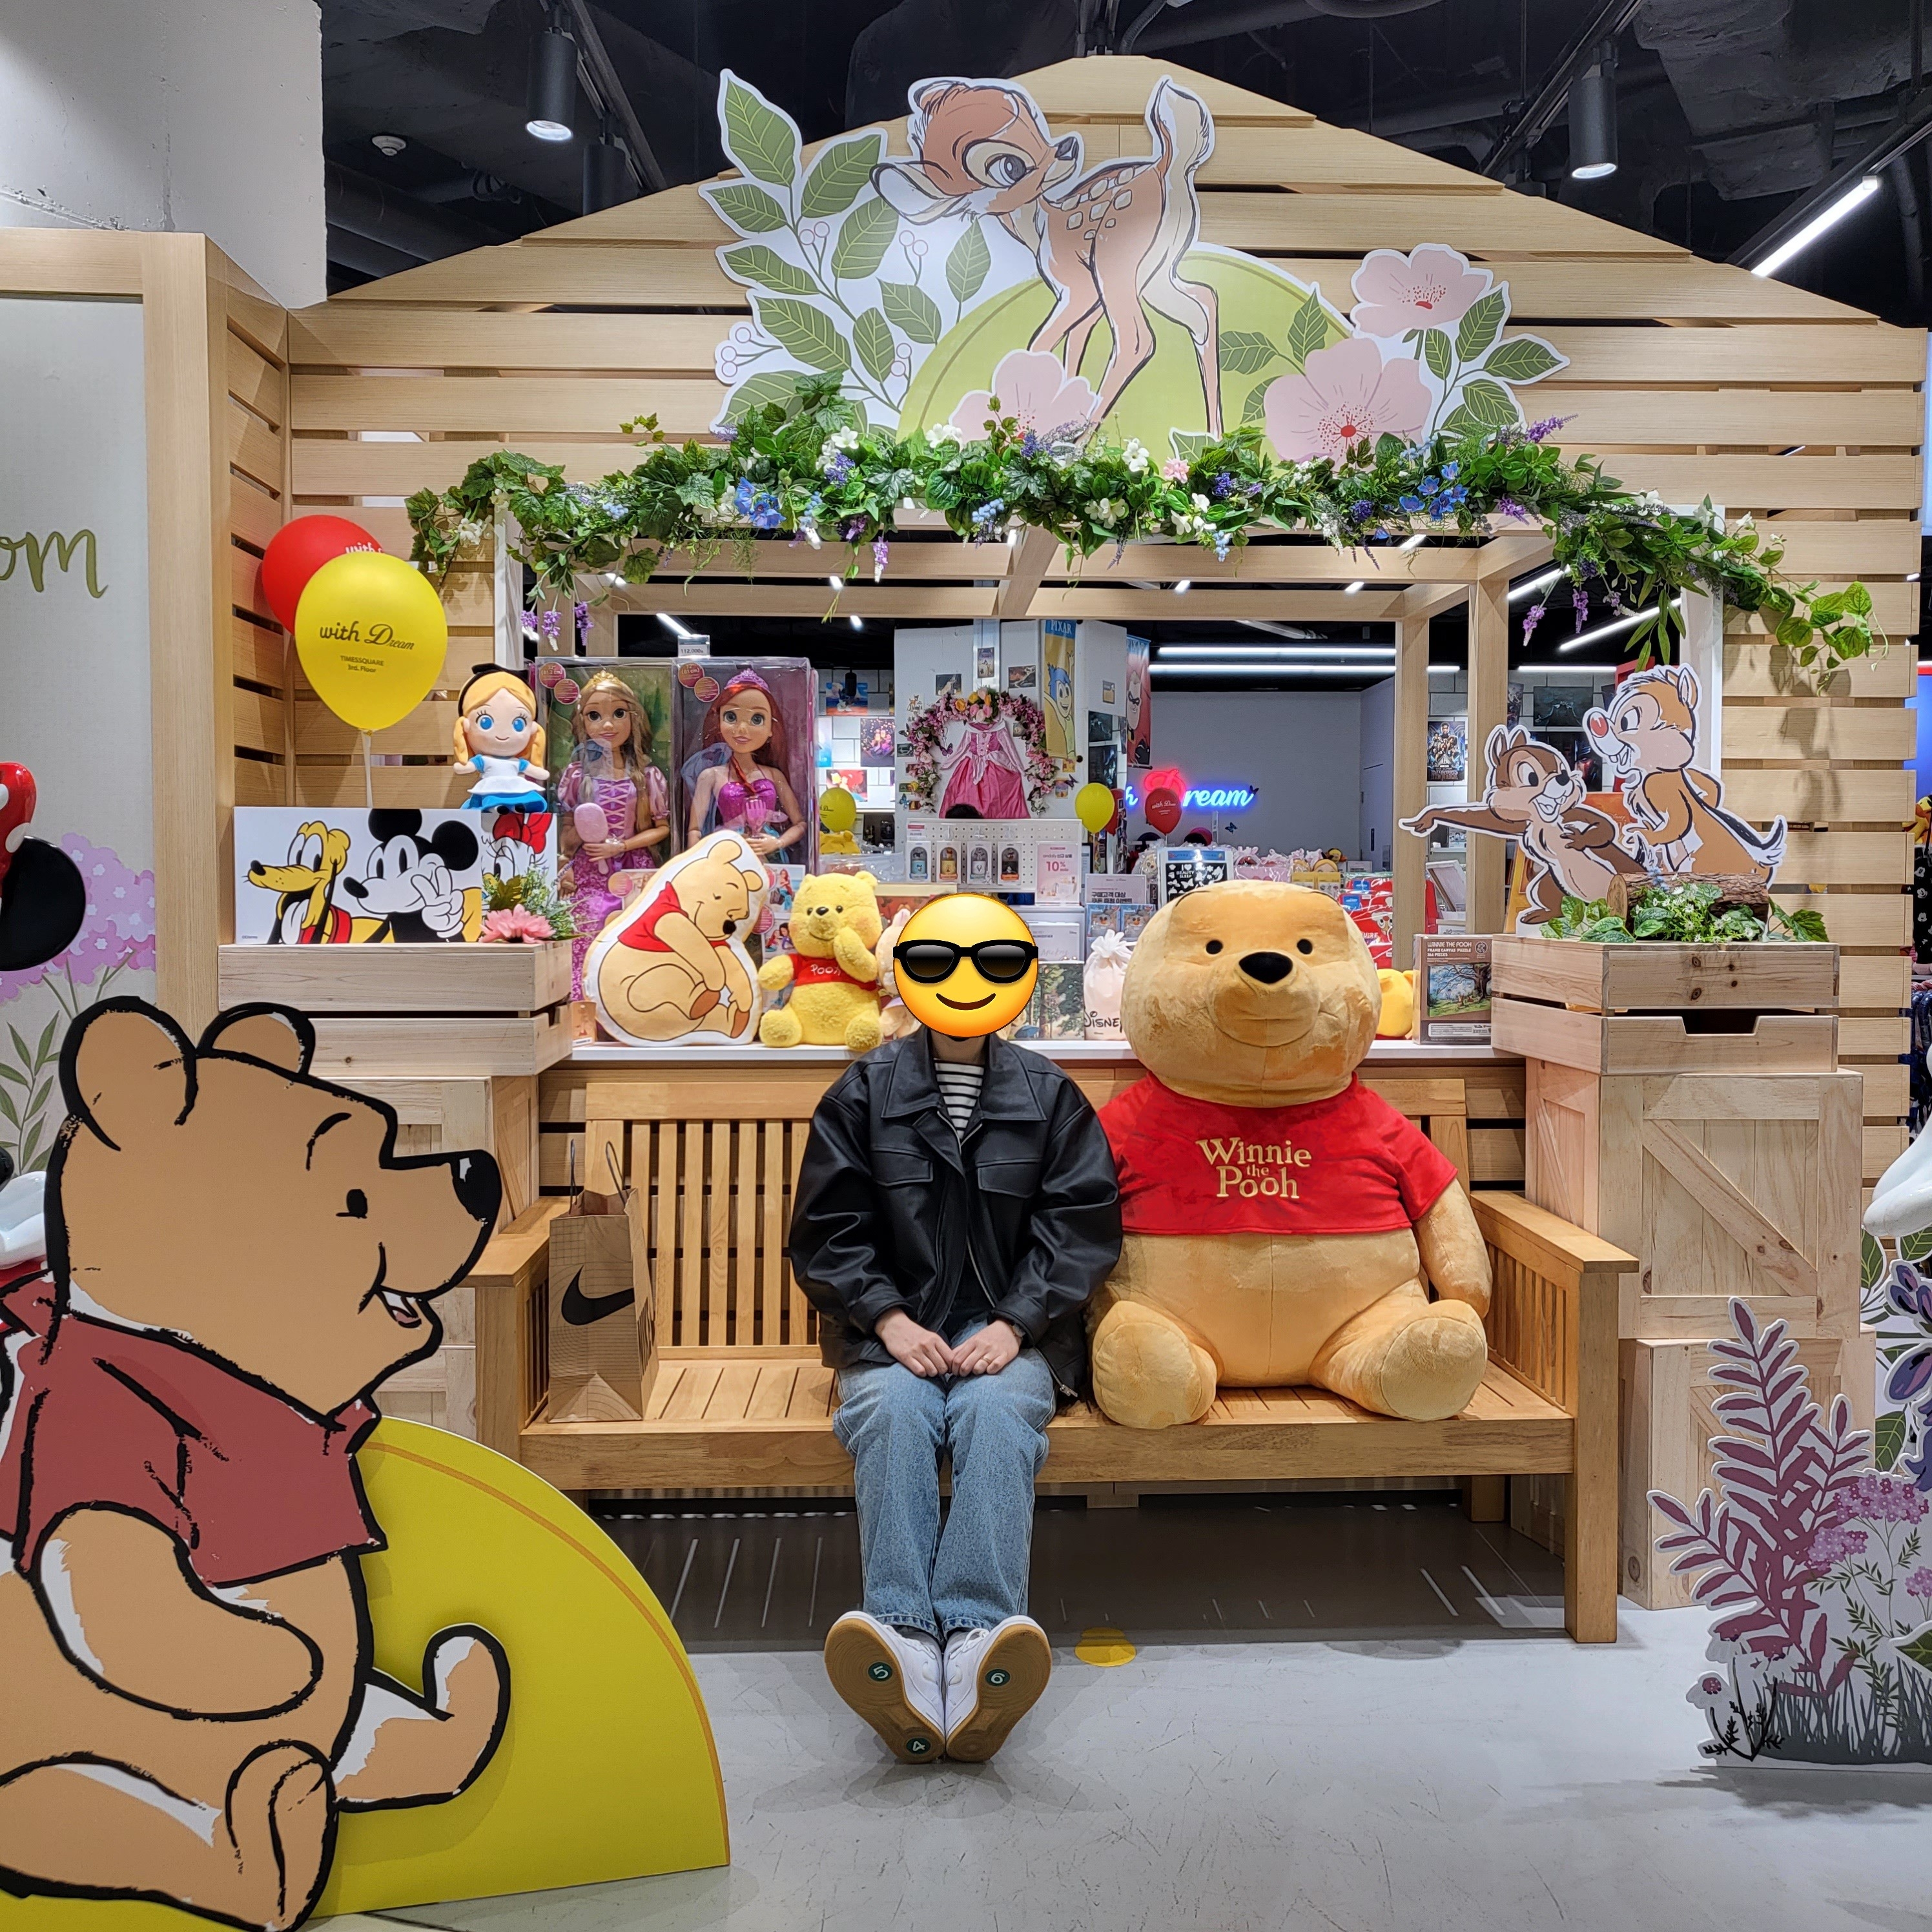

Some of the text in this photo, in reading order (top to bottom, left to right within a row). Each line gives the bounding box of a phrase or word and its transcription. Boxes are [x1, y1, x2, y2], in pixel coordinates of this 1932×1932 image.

[1051, 620, 1072, 635] PIXAR
[319, 621, 415, 651] with Dream
[340, 655, 384, 666] TIMESSQUARE
[1195, 1136, 1312, 1168] Winnie
[1246, 1164, 1270, 1178] the
[1216, 1165, 1300, 1199] Pooh
[873, 1665, 889, 1679] 5
[991, 1672, 1005, 1684] 6
